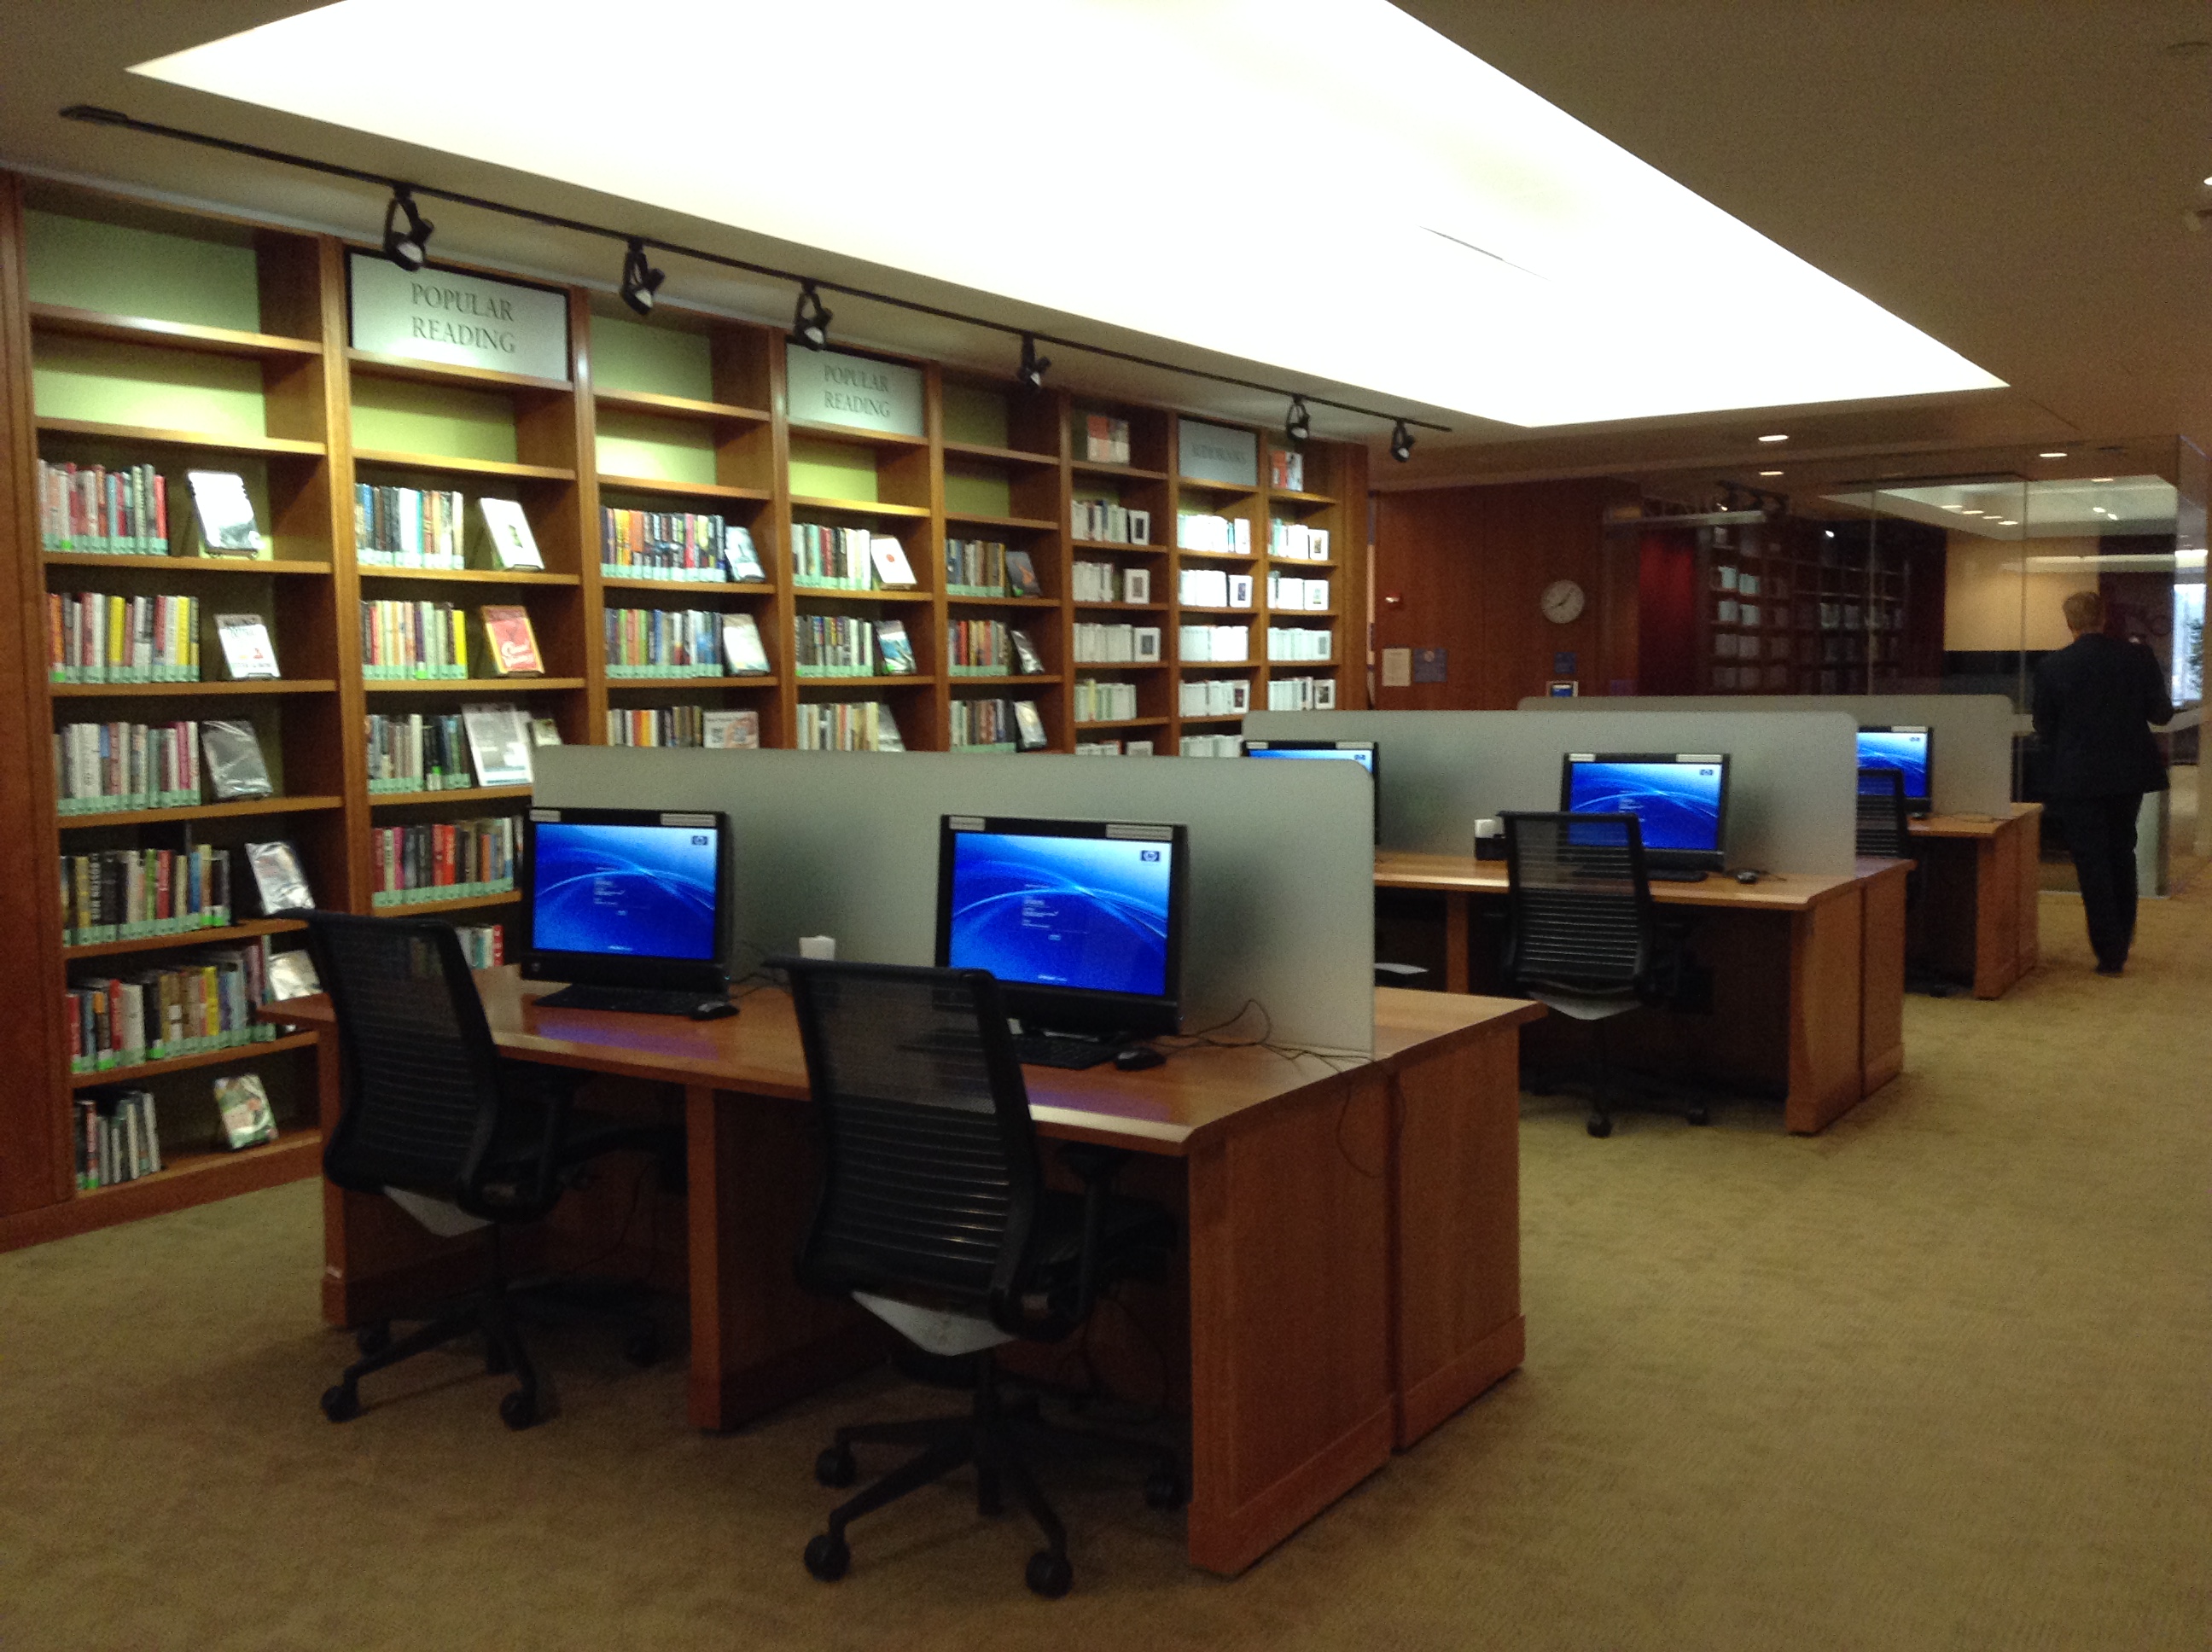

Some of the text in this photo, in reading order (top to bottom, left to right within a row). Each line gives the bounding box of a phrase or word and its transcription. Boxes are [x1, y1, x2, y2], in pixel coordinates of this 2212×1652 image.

[411, 282, 514, 321] POPULAR
[411, 316, 515, 353] READING
[824, 364, 888, 392] POPULAR
[824, 391, 890, 417] READING
